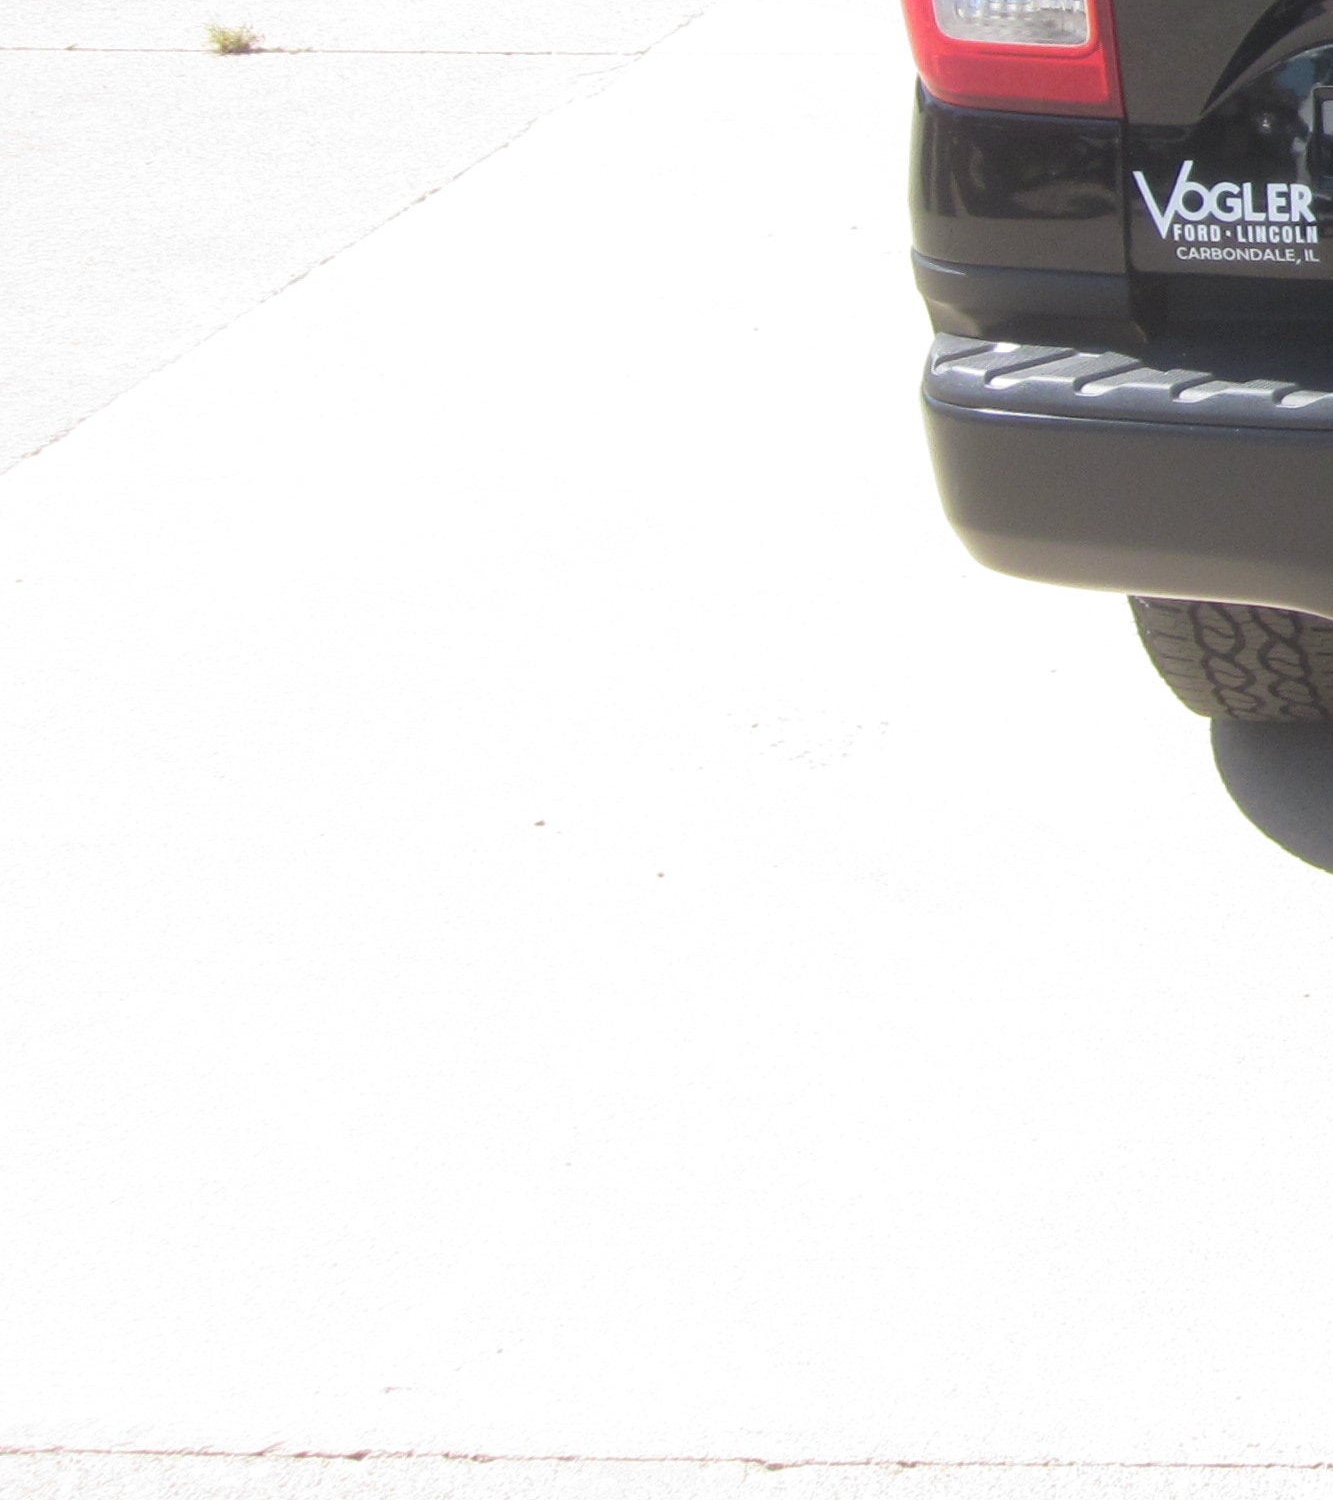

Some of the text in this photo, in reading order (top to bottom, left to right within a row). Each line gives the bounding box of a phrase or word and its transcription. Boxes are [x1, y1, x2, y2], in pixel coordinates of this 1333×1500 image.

[1131, 159, 1317, 240] VOGLER
[1172, 223, 1319, 244] FORD LINCOLN
[1175, 246, 1320, 265] CARBONDALE, IL
